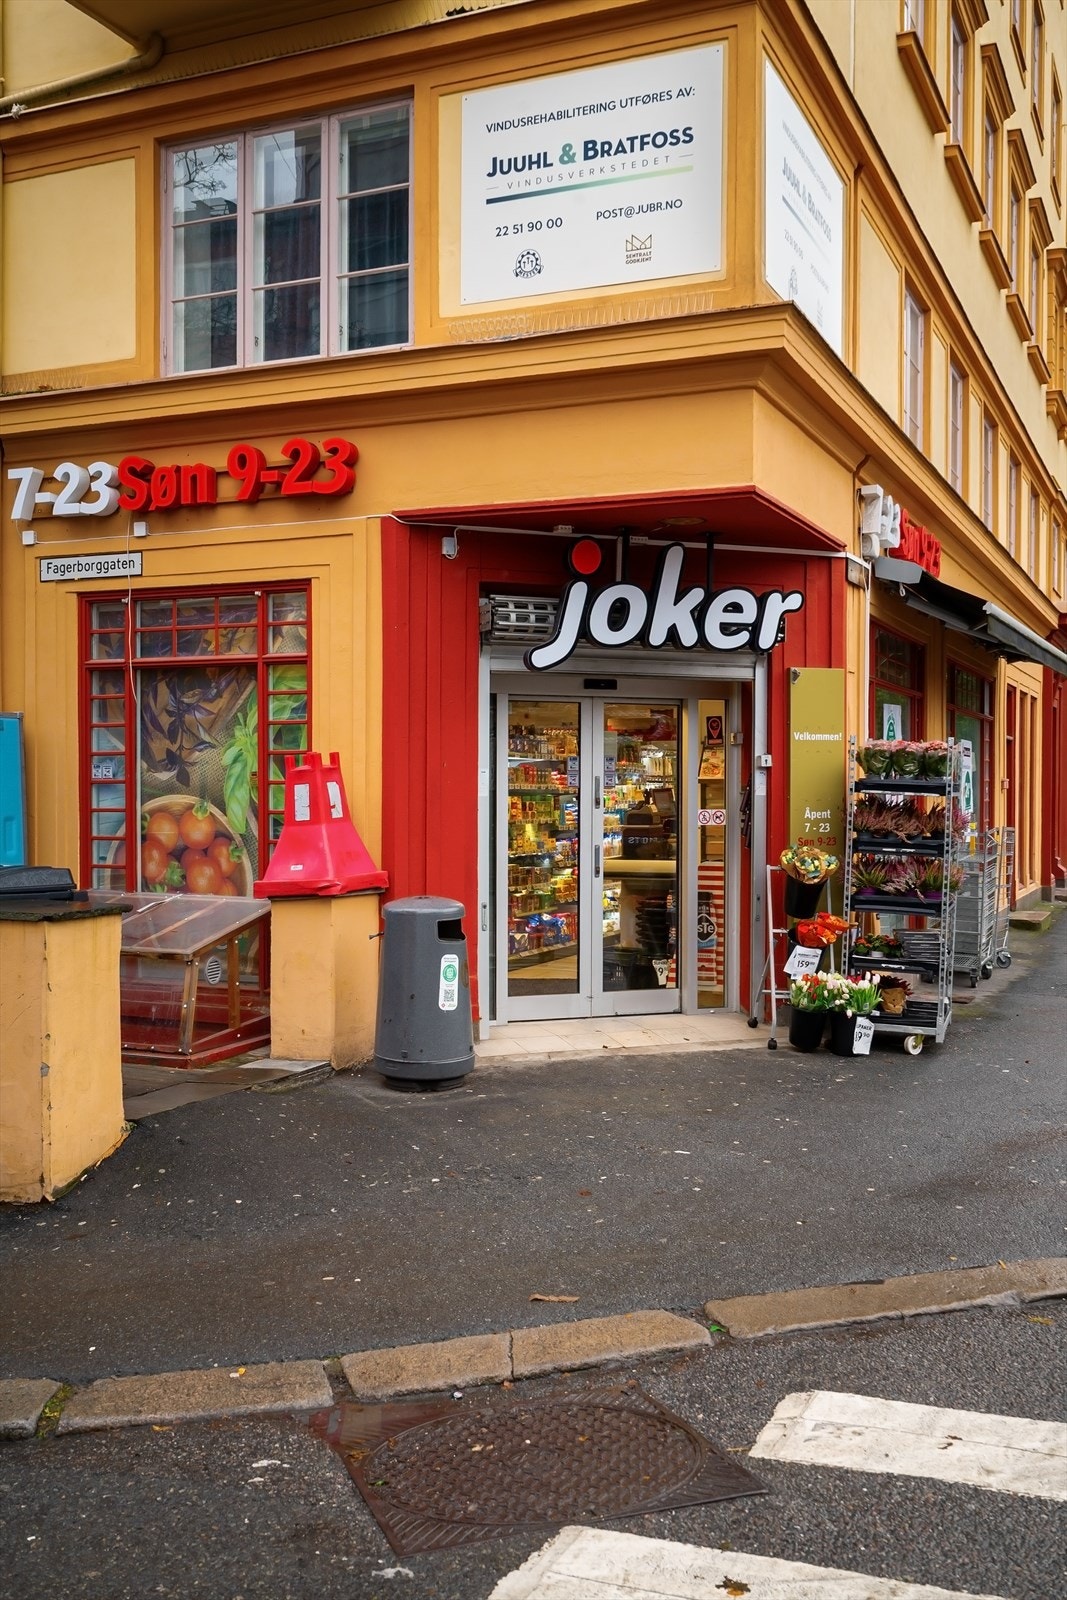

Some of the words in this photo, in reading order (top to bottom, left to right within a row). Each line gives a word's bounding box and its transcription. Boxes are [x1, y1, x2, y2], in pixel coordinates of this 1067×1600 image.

[486, 101, 616, 133] VINDUSREHABILITERING
[619, 90, 673, 109] UTFØRES
[676, 86, 696, 99] AV:
[558, 143, 577, 165] &
[507, 155, 671, 190] VINDUSVERKSTEDET
[596, 198, 683, 221] POST@JUBR.NO
[495, 226, 509, 237] 22
[512, 223, 524, 234] 51
[527, 220, 543, 232] 90
[546, 217, 563, 229] 00
[8, 461, 121, 520] 7-23
[117, 455, 217, 512] Søn
[227, 437, 359, 501] 9-23
[46, 556, 136, 576] Fagerborggaten
[525, 536, 804, 670] joker
[793, 731, 843, 741] Velkommen!
[804, 806, 831, 820] Åpent
[804, 823, 811, 833] 7
[819, 822, 831, 833] 23
[797, 837, 815, 847] Søn
[817, 836, 837, 846] 9-23
